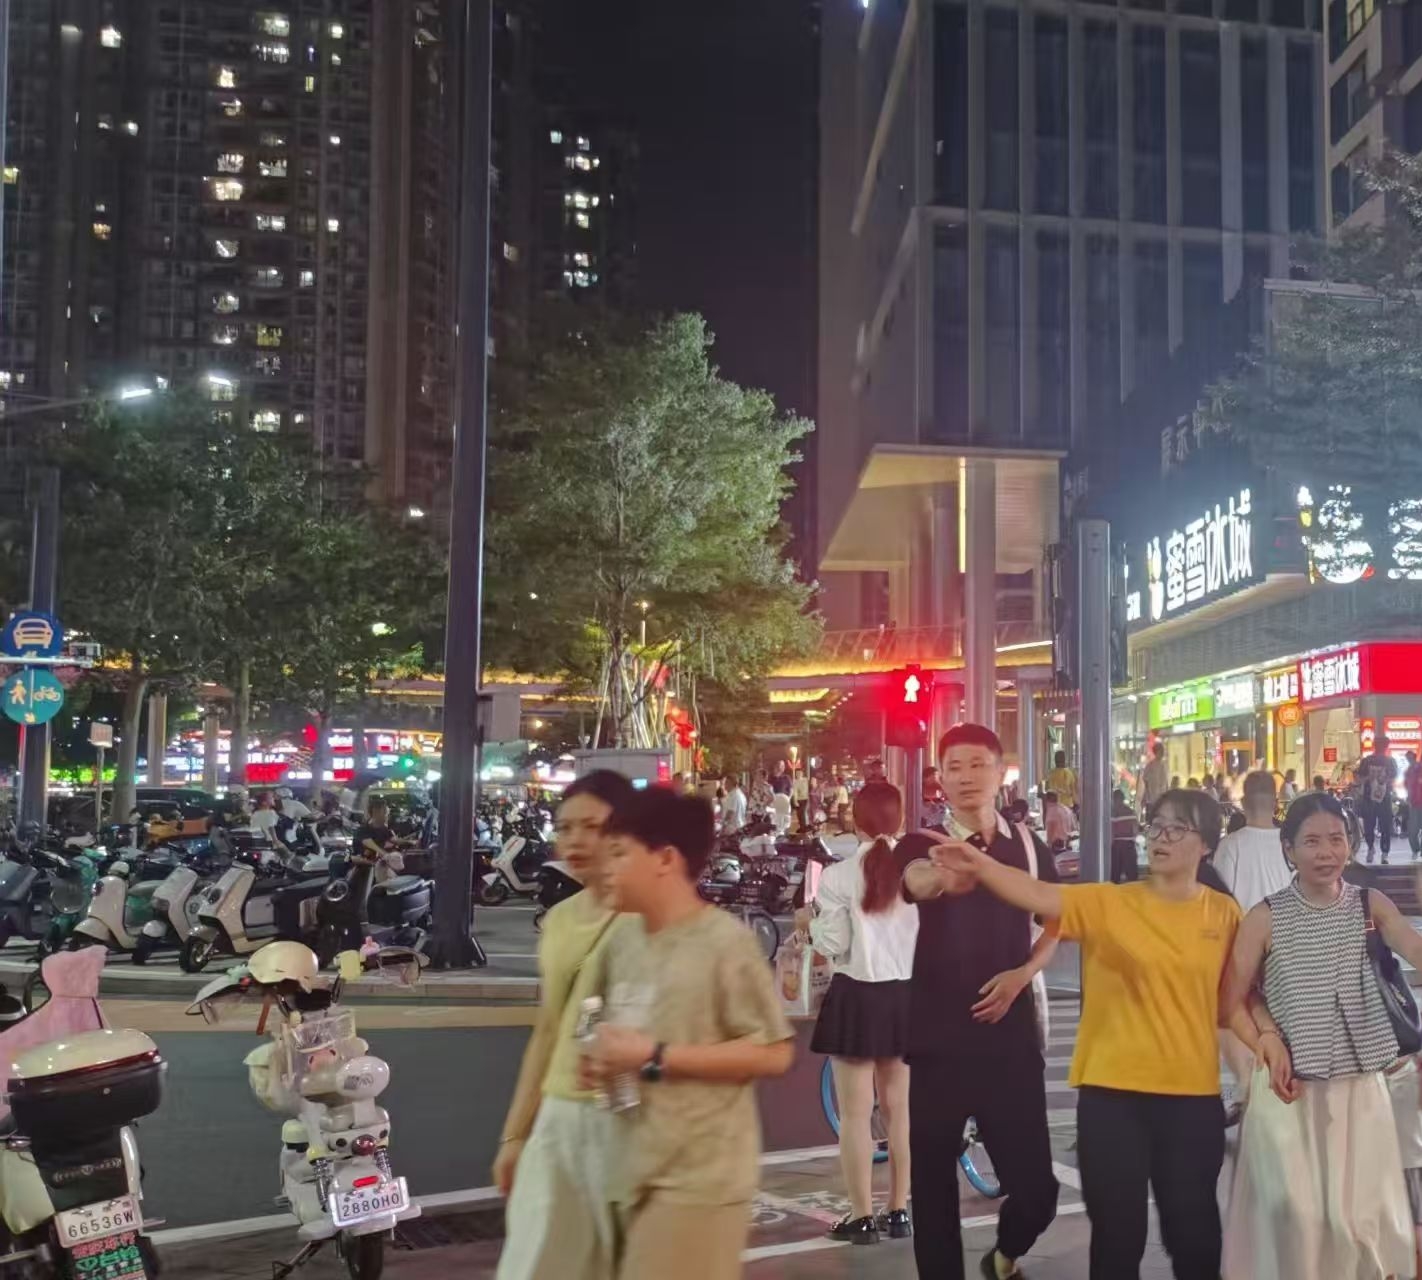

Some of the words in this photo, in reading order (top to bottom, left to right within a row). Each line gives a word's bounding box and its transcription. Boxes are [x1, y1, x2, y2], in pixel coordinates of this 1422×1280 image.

[1166, 488, 1252, 611] 蜜雪冰城
[68, 1210, 134, 1238] 66536W
